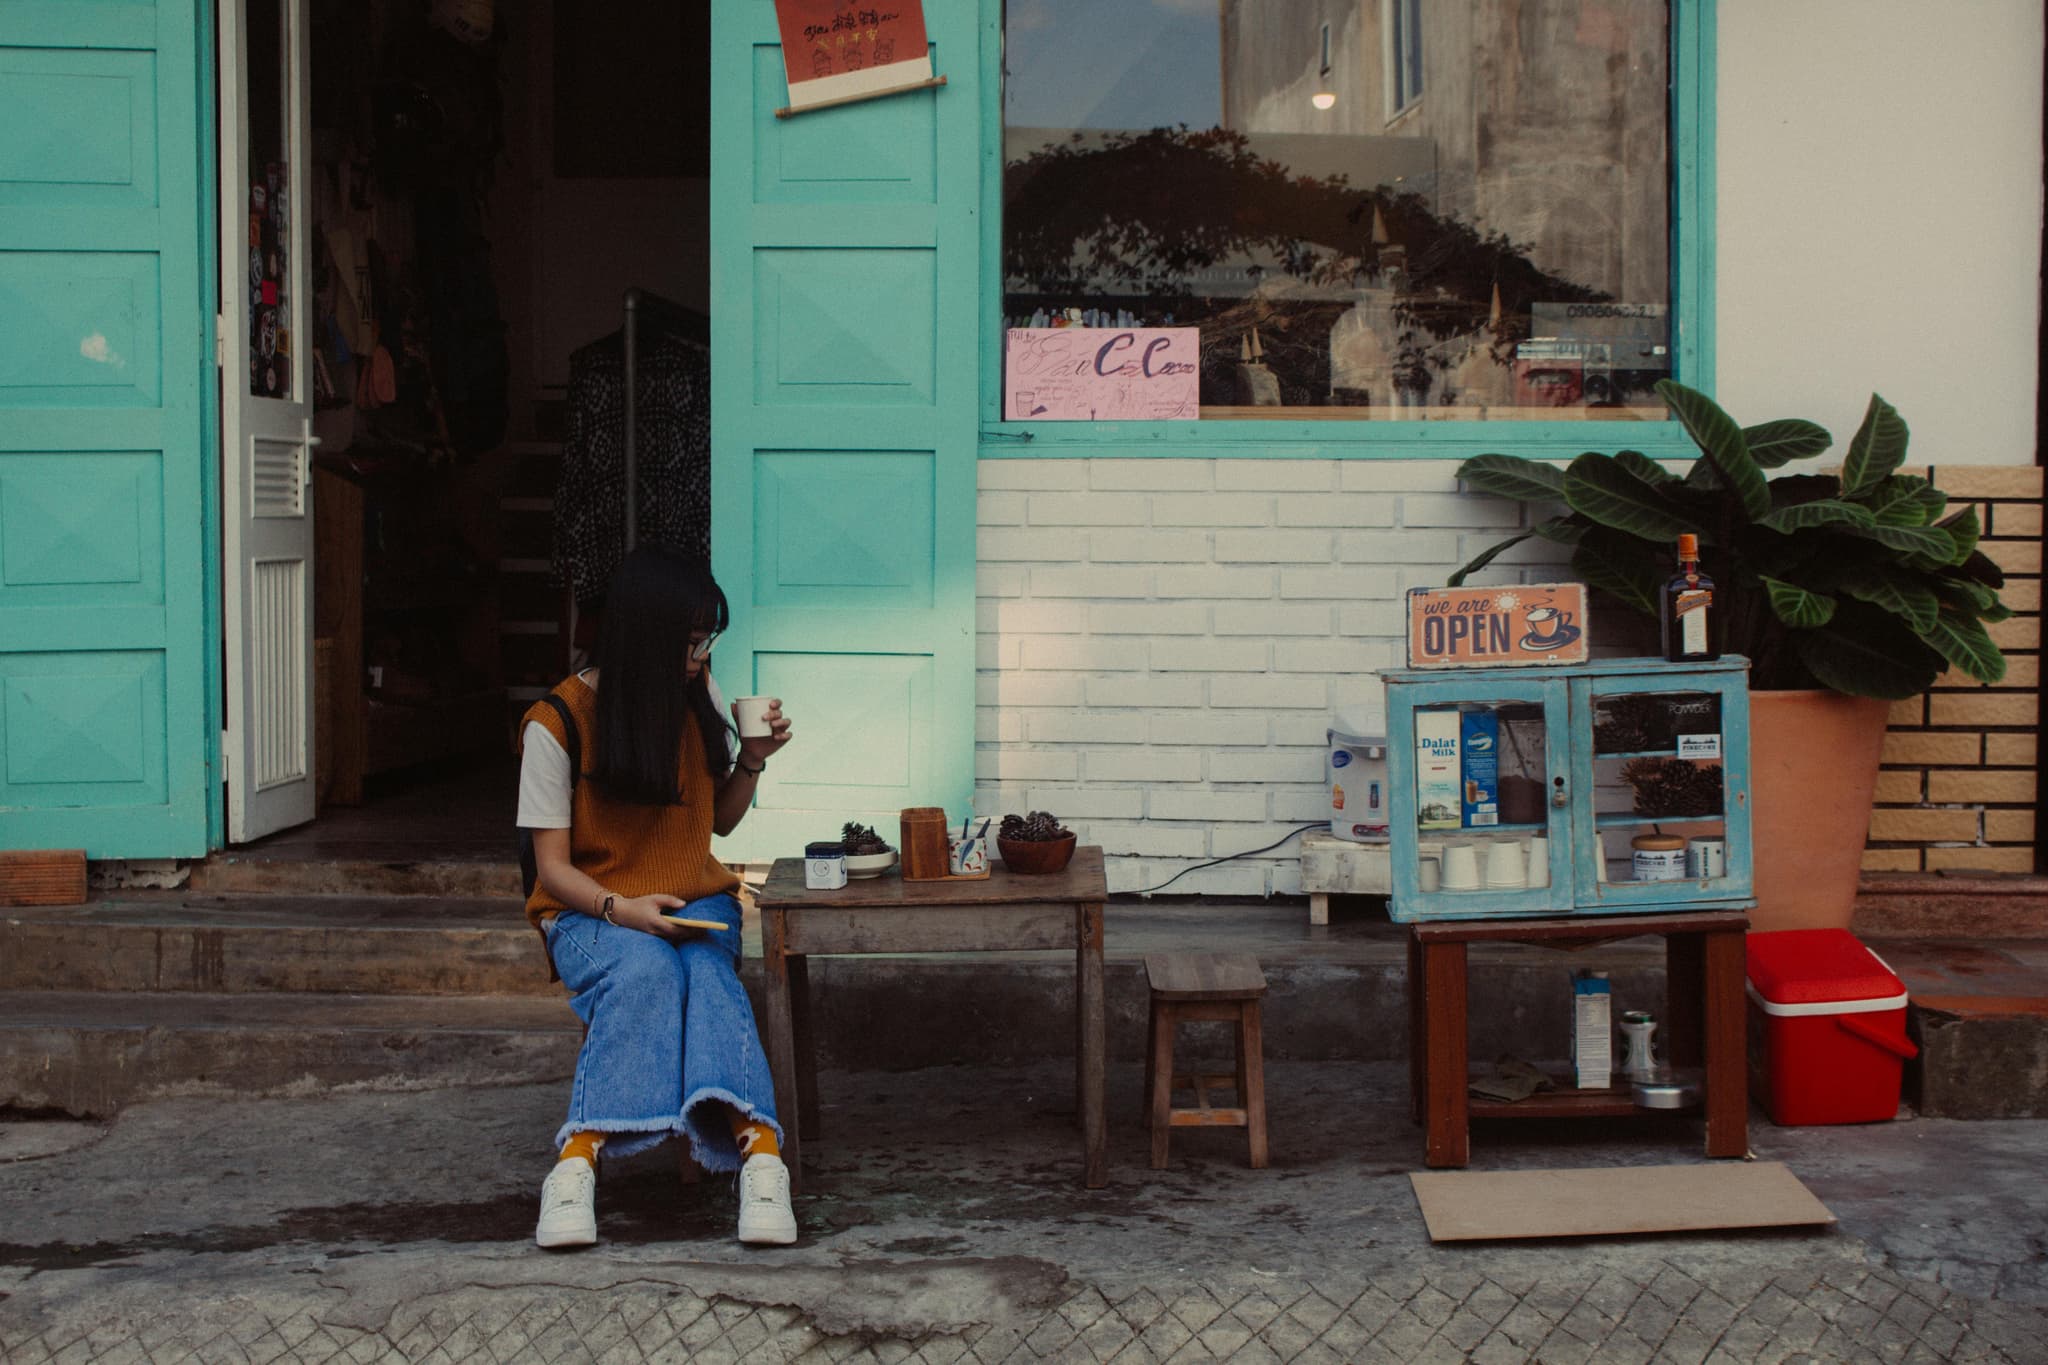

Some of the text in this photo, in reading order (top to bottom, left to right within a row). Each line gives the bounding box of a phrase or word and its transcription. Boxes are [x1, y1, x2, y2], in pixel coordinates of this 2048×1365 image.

[1424, 598, 1492, 615] we are
[1424, 612, 1511, 656] OPEN
[1422, 737, 1456, 749] Dalat
[1432, 748, 1456, 757] Milk
